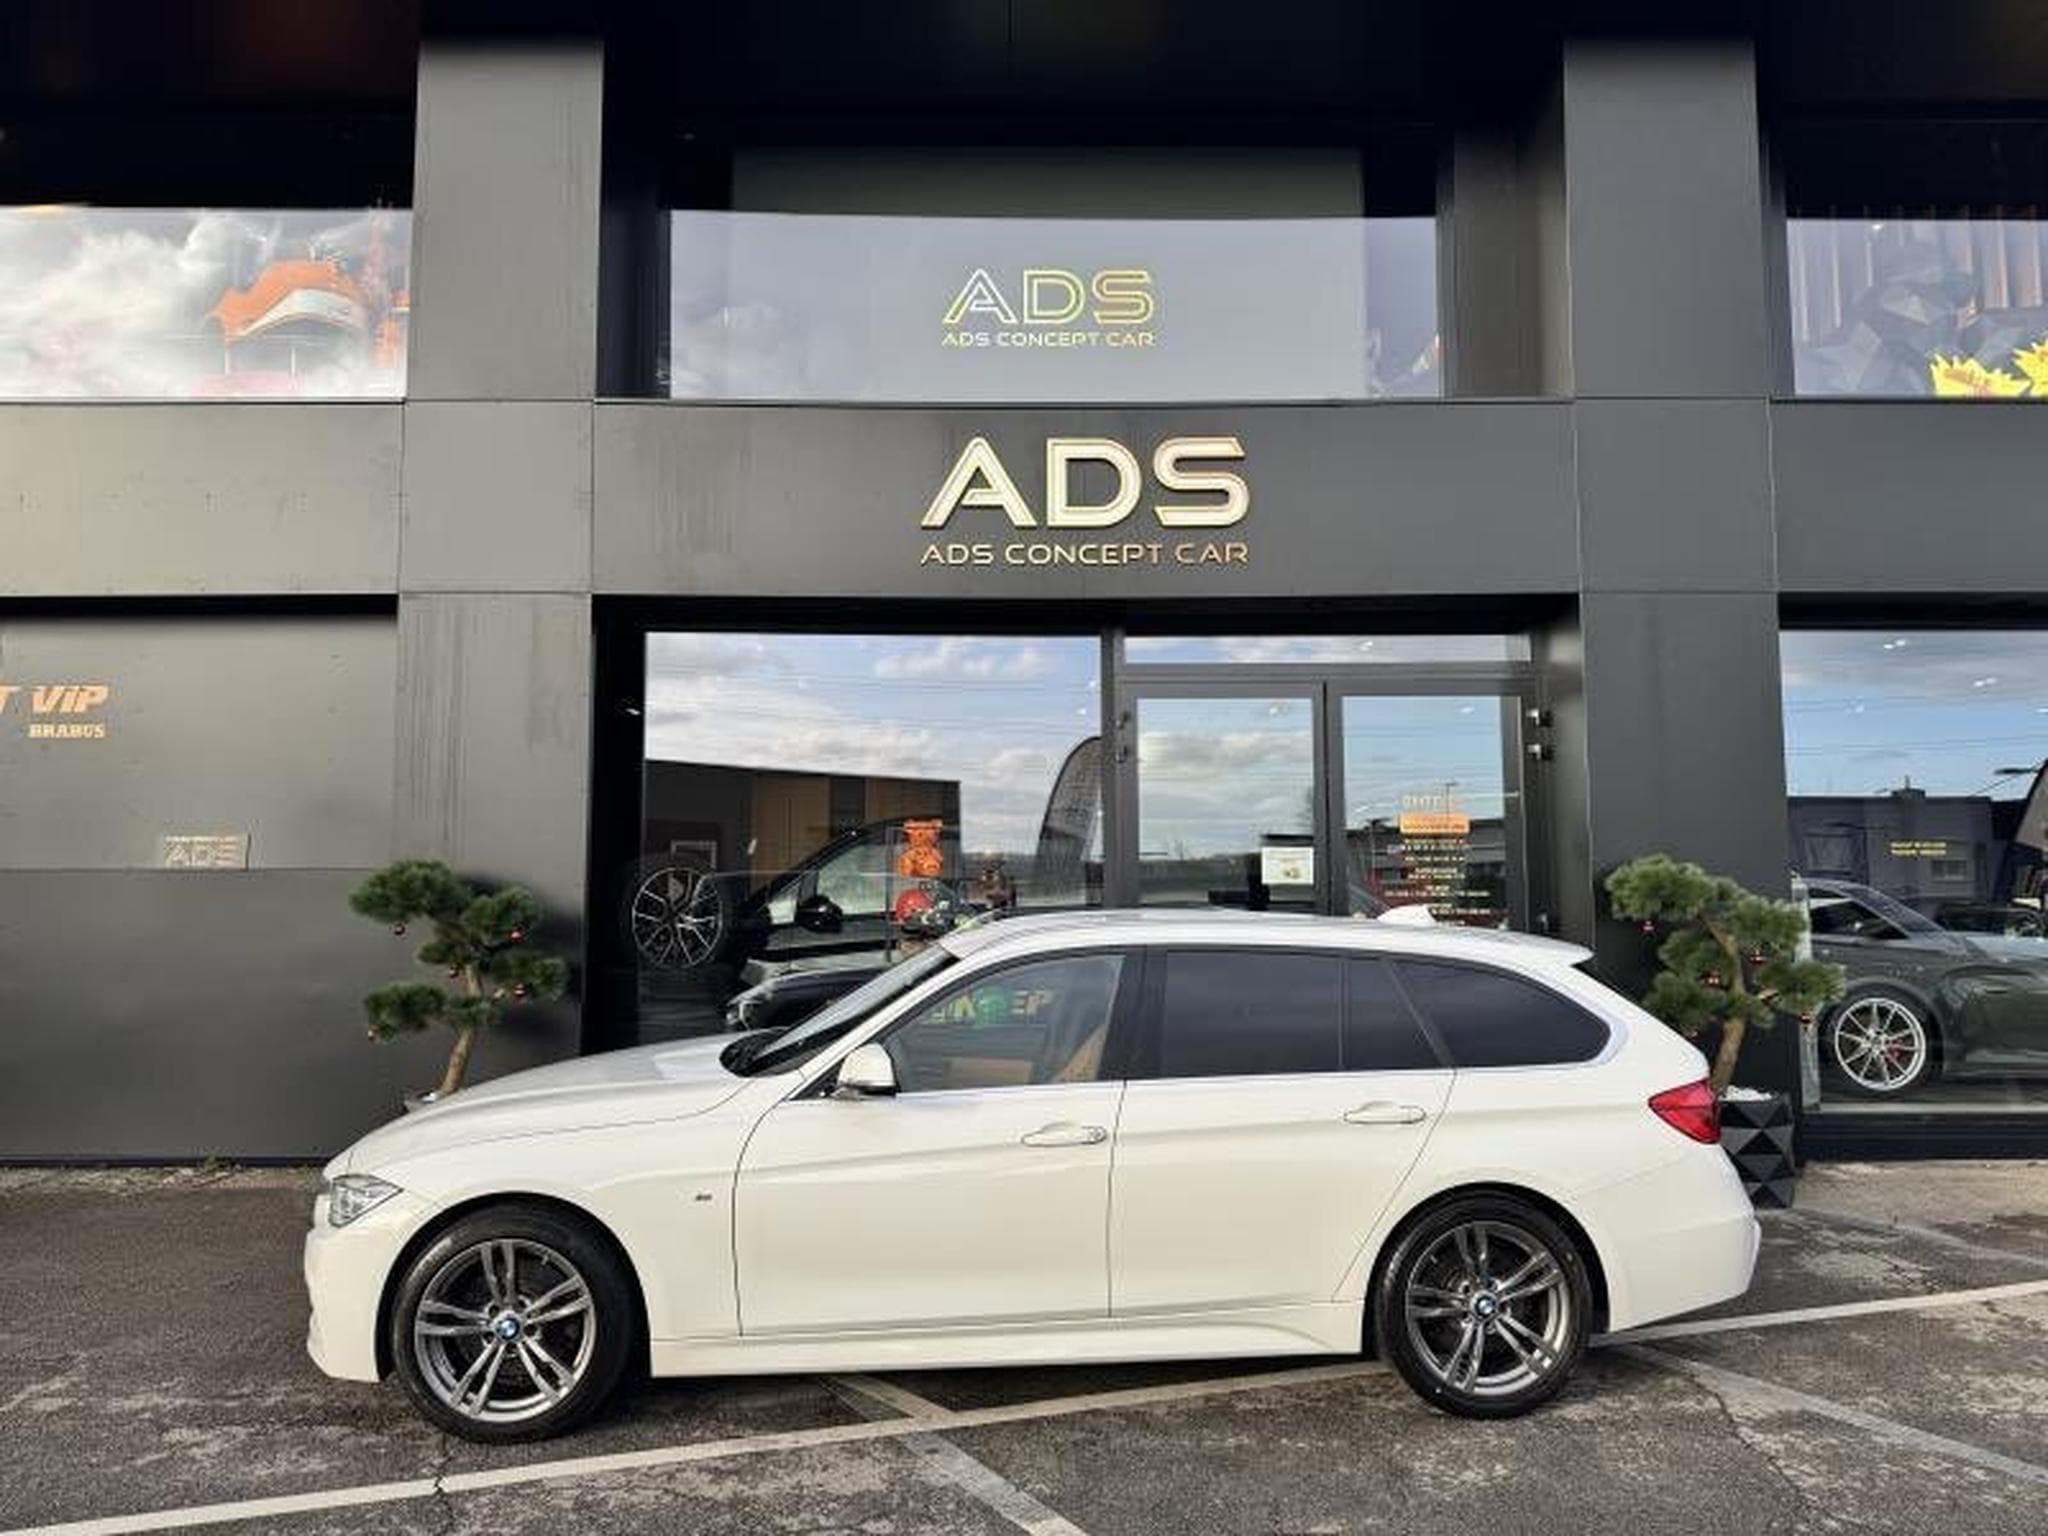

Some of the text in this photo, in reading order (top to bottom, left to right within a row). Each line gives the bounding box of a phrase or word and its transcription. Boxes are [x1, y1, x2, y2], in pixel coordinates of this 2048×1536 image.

[942, 268, 1156, 325] ADS
[941, 332, 1157, 347] ADS CONCEPT CAR
[920, 435, 1251, 529] ADS
[920, 542, 1250, 566] ADS CONCEPT CAR
[28, 723, 106, 739] BRABUS
